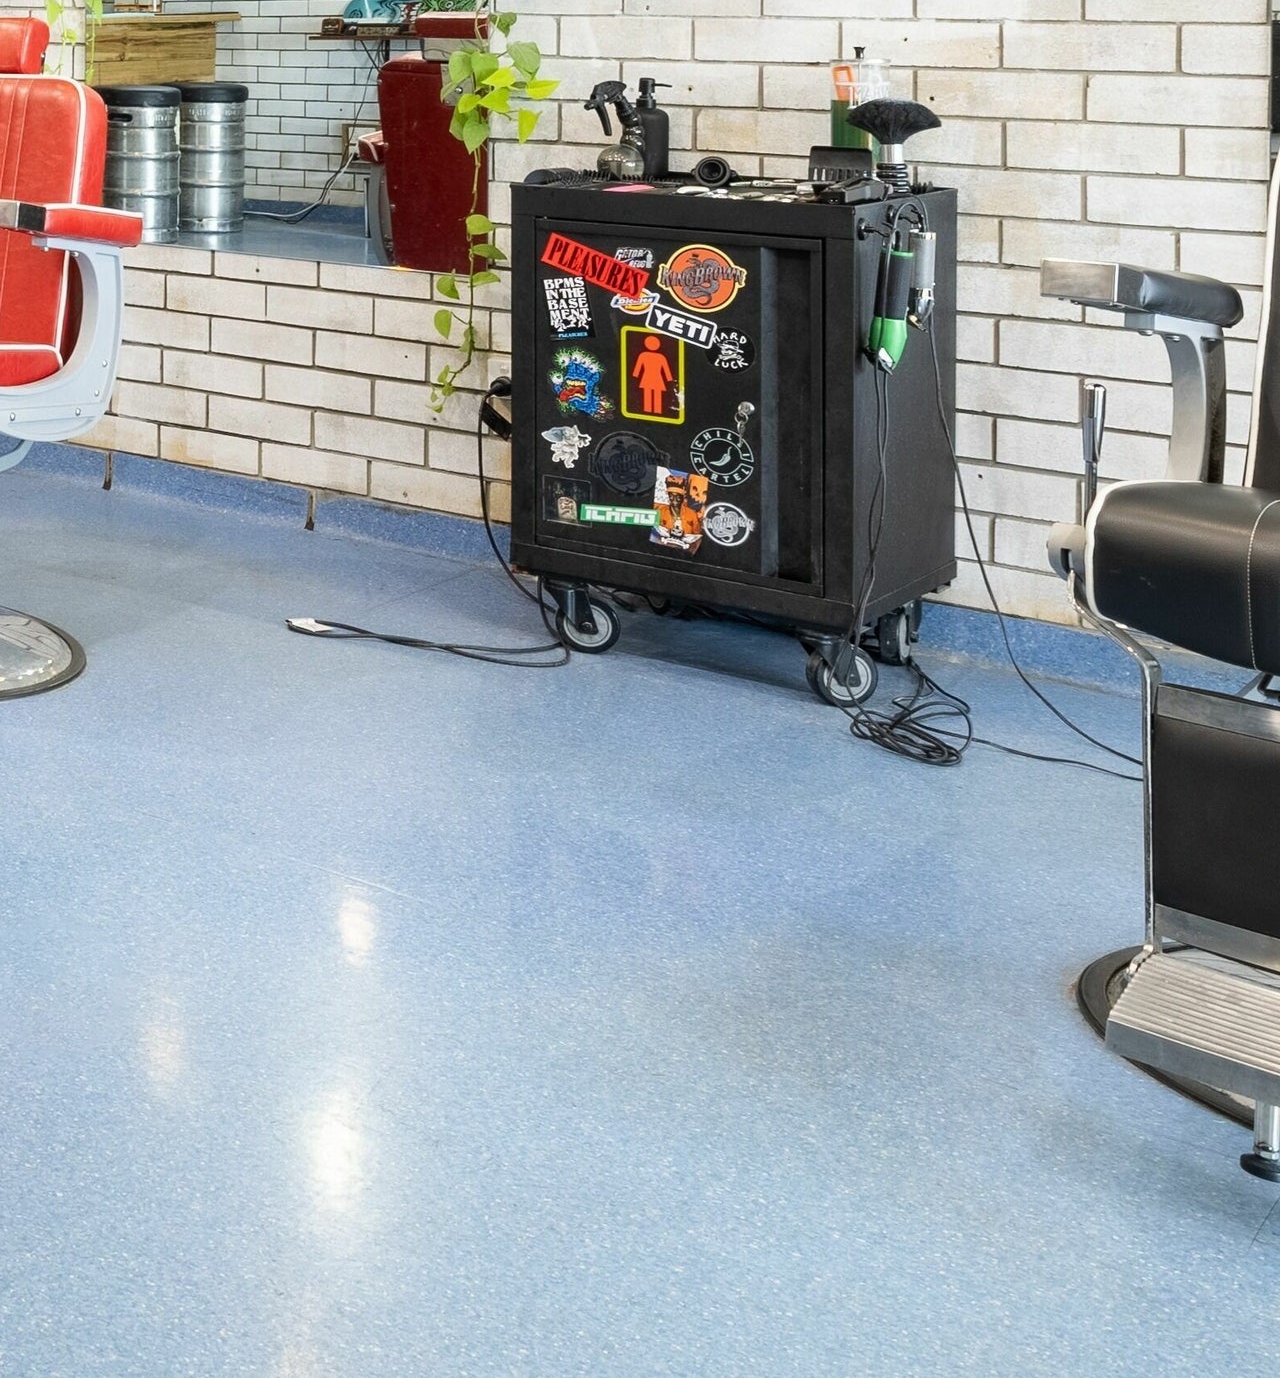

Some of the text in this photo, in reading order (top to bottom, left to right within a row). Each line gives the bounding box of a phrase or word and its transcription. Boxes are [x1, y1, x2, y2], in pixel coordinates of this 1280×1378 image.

[548, 237, 643, 296] PLEASURES
[543, 276, 585, 290] BPMS
[545, 287, 587, 300] IN THE
[547, 298, 589, 310] BASE
[549, 308, 590, 325] MENT
[654, 308, 712, 343] YETI
[712, 331, 747, 344] HARD
[714, 357, 749, 370] LUCK
[693, 457, 751, 484] CARTEL
